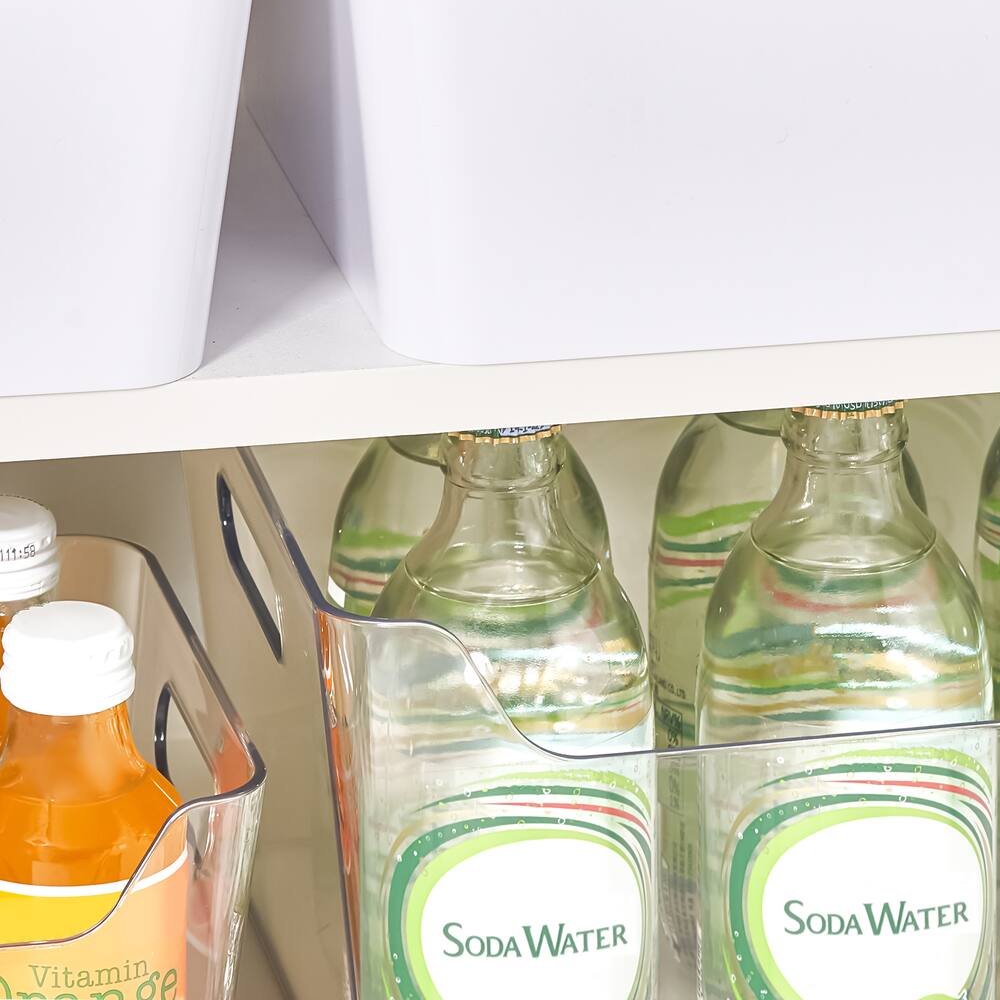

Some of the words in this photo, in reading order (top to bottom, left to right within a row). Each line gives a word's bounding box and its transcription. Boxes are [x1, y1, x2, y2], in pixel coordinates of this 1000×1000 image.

[783, 899, 864, 936] SODA
[863, 900, 969, 936] WATER
[442, 922, 522, 958] SODA
[522, 922, 628, 959] WATER
[28, 959, 149, 989] Vitamin
